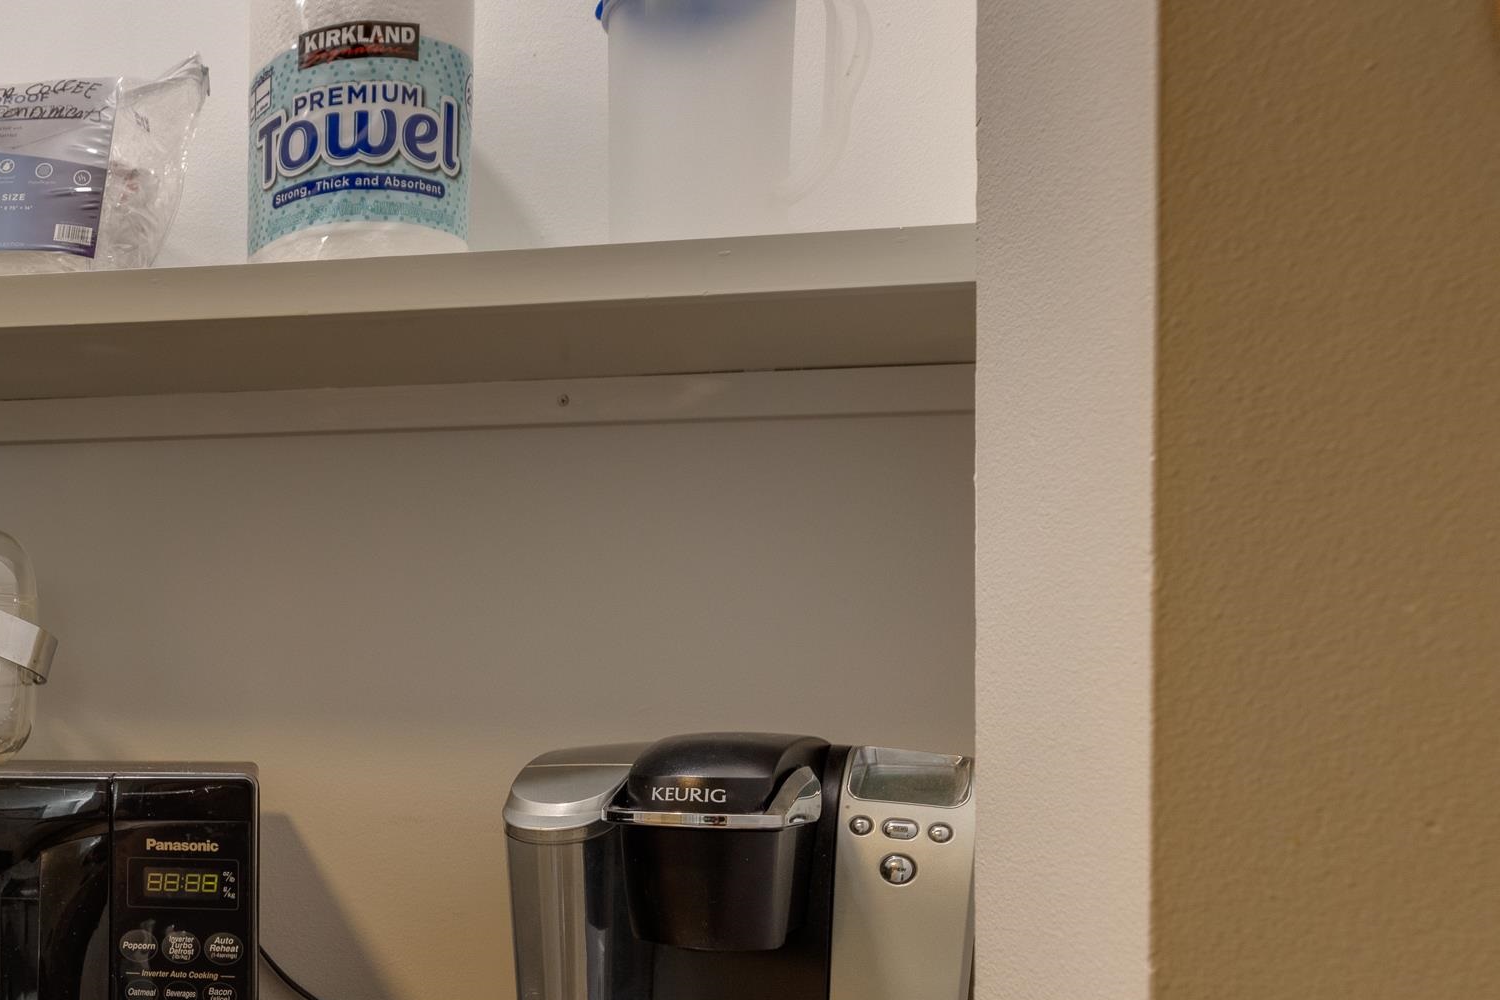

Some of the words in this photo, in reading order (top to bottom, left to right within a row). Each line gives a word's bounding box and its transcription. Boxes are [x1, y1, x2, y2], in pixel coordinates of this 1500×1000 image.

[304, 24, 417, 54] KIRKLAND
[294, 83, 420, 116] PREMIUM
[257, 100, 457, 185] Towel
[275, 184, 312, 206] Strong,
[316, 175, 350, 193] Thick
[354, 174, 380, 187] and
[384, 174, 442, 196] Absorbent
[2, 193, 26, 201] SIZE
[651, 786, 727, 803] KEURIG
[145, 838, 220, 852] Panasonic
[122, 941, 156, 951] Popcorn
[213, 937, 234, 945] Auto
[209, 944, 239, 953] Reheat
[141, 969, 169, 978] Inverter
[169, 970, 187, 979] Auto
[188, 970, 219, 981] Cooking
[127, 987, 156, 997] Oatmeal
[165, 989, 196, 999] Beverages
[208, 987, 233, 996] Bacon
